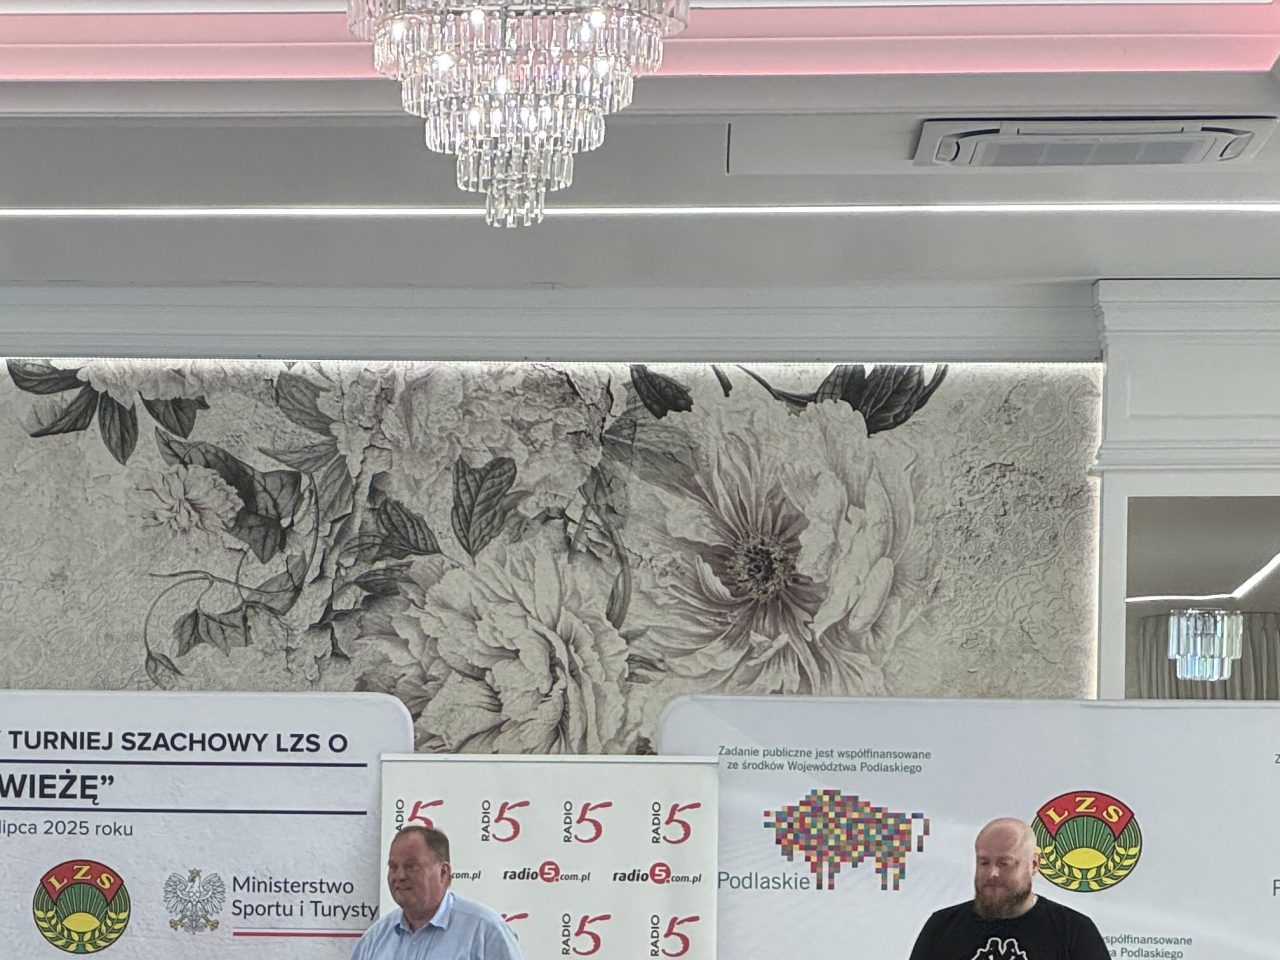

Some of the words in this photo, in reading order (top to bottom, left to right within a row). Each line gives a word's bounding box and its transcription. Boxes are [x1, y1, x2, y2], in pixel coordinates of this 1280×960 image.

[8, 730, 114, 750] TURNIEJ
[121, 732, 269, 752] SZACHOWY
[276, 733, 320, 753] LZS
[328, 733, 348, 753] O
[718, 745, 759, 757] Zadanie
[763, 747, 812, 761] publiczne
[815, 748, 834, 760] jest
[837, 749, 932, 761] współfinansowane
[727, 762, 738, 770] ze
[742, 760, 784, 771] środków
[787, 761, 856, 773] Województwa
[860, 762, 922, 774] Podlaskiego
[395, 799, 404, 832] ADIO
[481, 800, 491, 841] RADIO
[492, 800, 530, 842] 5
[563, 800, 572, 842] RADIO
[574, 801, 612, 843] 5
[652, 801, 661, 843] RADIO
[663, 802, 701, 844] 5
[1045, 797, 1124, 825] LZS
[44, 821, 89, 835] 2025
[96, 821, 133, 836] roku
[49, 865, 115, 891] LZS
[233, 876, 354, 894] Ministerstwo
[718, 871, 810, 890] Podlaskie
[231, 900, 293, 920] Sportu
[300, 900, 304, 916] i
[309, 901, 380, 920] Turysty
[562, 913, 571, 955] RADIO
[572, 914, 611, 956] 5
[650, 914, 660, 957] RADIO
[661, 915, 700, 957] 5
[1120, 948, 1183, 960] Podlaskiego
